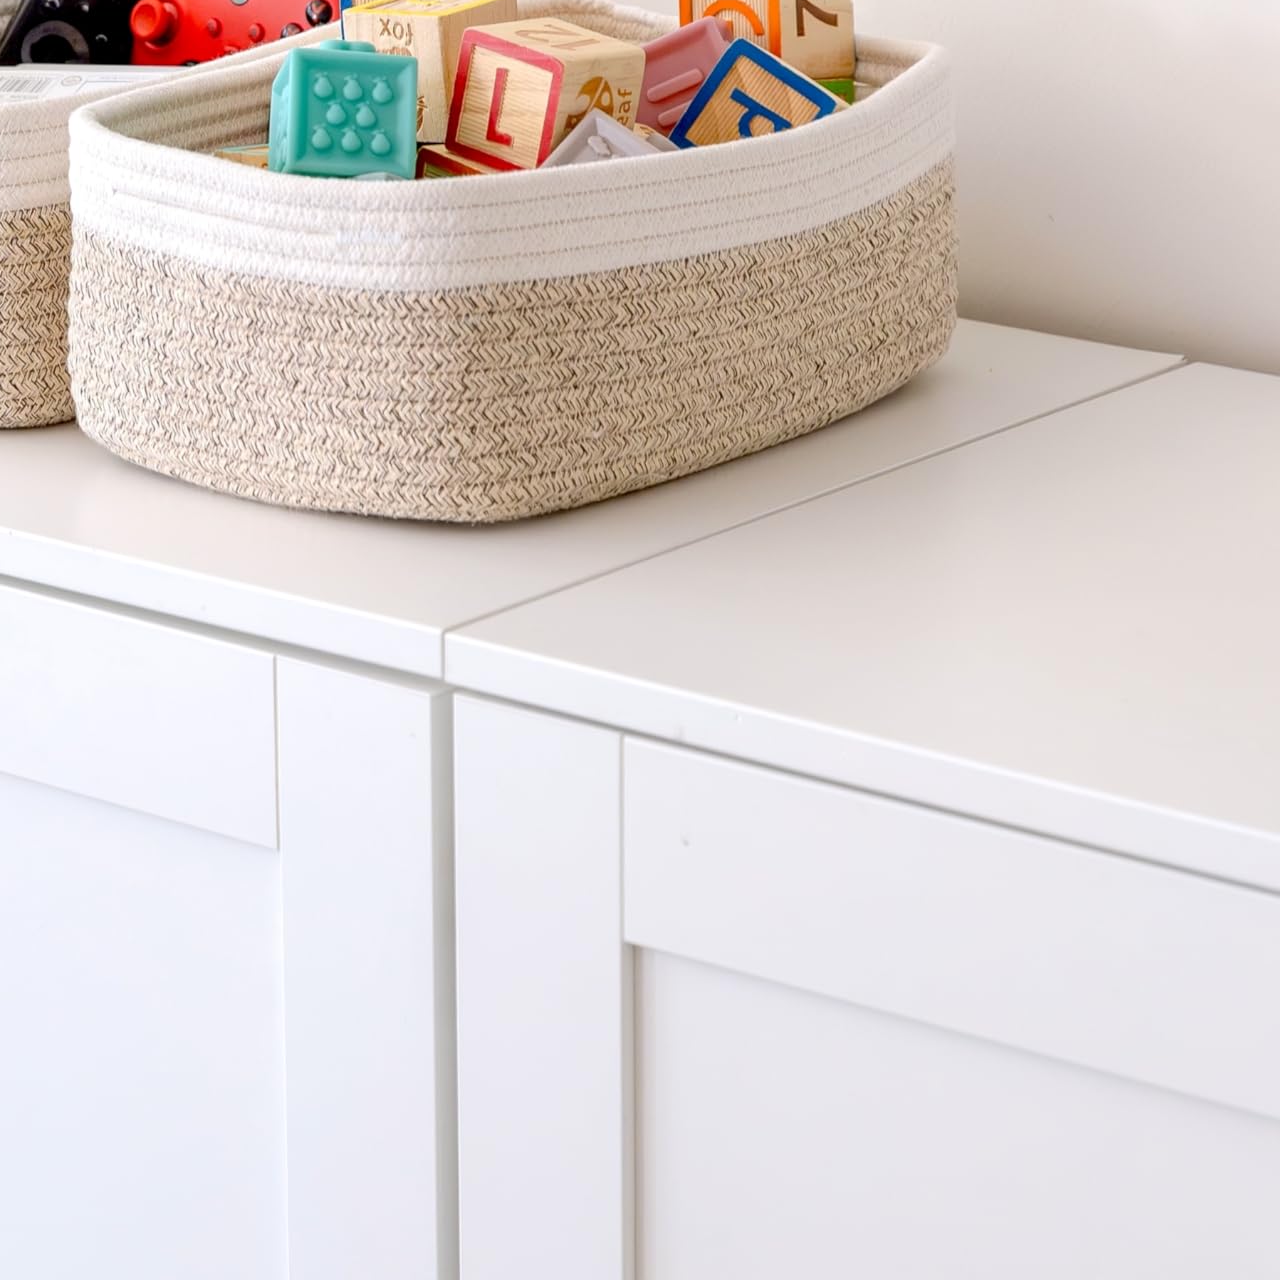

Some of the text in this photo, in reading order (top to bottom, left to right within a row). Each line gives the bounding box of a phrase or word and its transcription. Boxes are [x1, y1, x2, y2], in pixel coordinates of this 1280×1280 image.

[379, 18, 413, 46] fox
[486, 67, 513, 147] L
[617, 88, 632, 126] eaf
